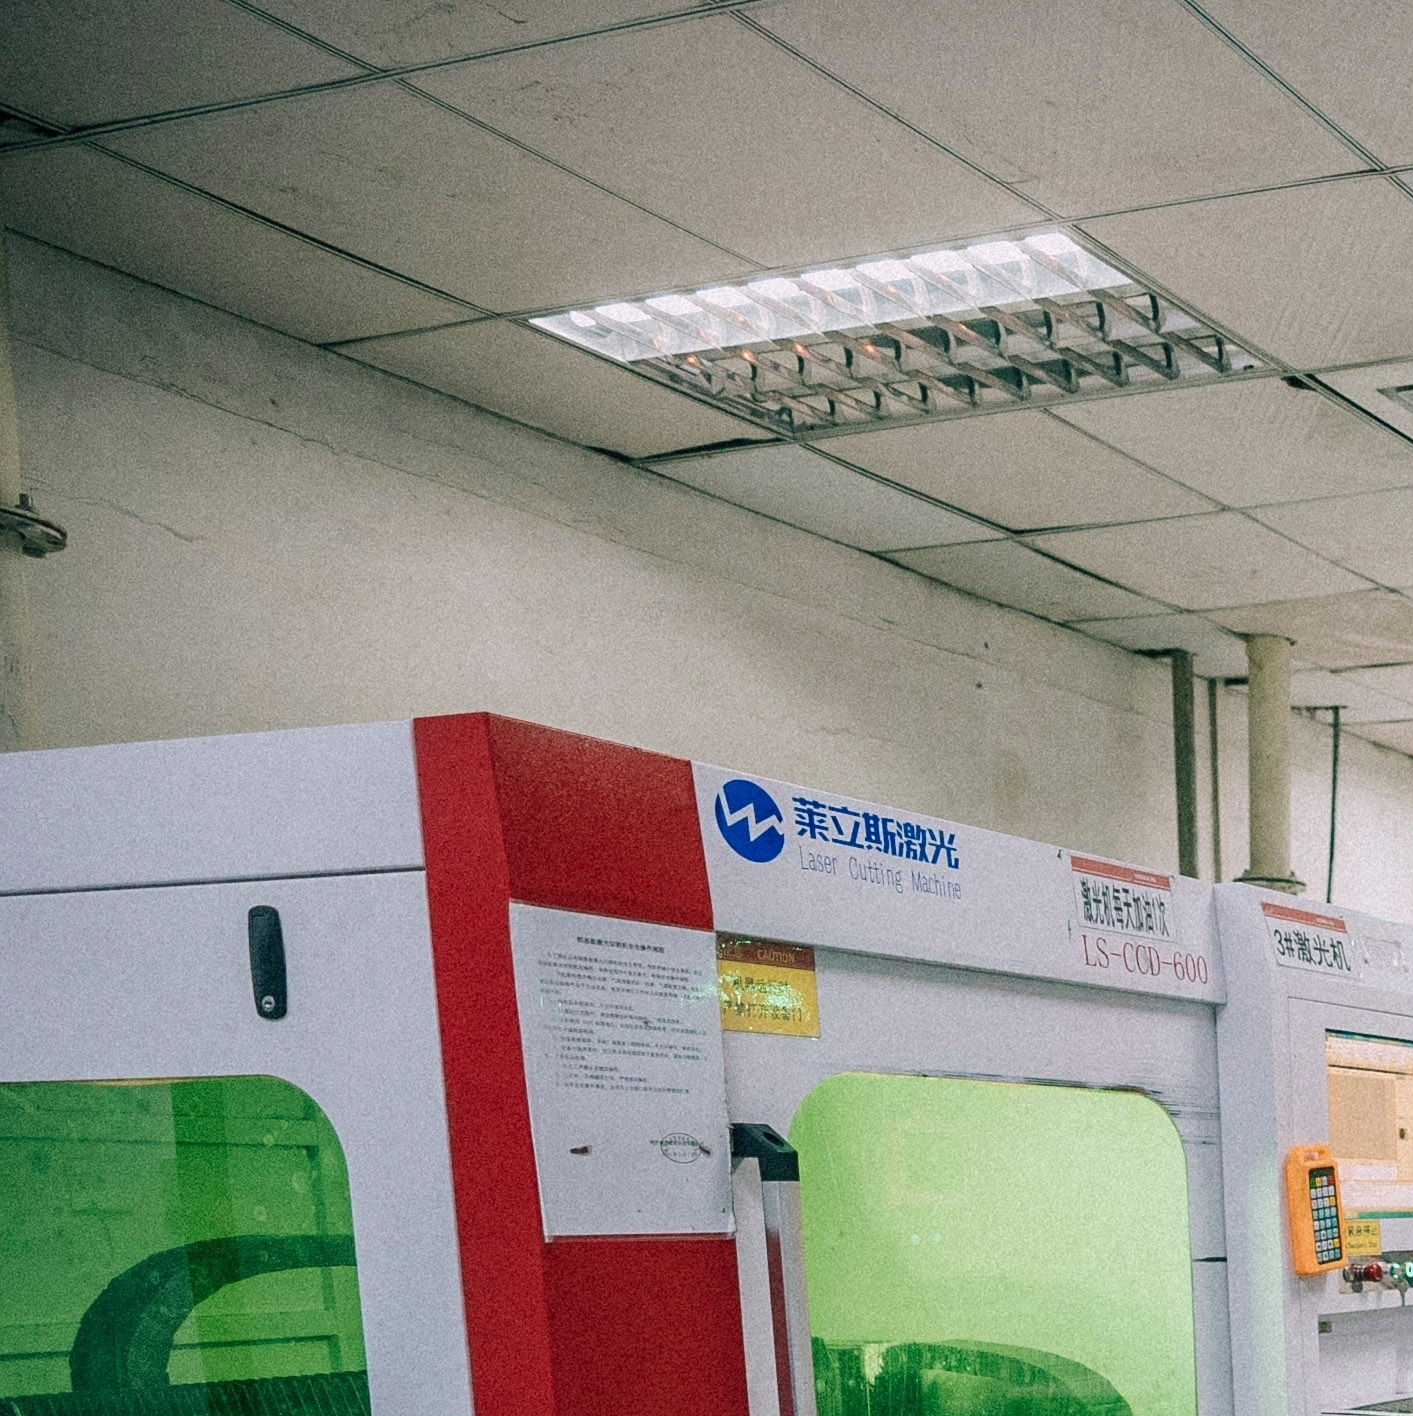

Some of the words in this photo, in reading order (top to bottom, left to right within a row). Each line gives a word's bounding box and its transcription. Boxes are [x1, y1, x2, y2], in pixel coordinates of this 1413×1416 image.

[791, 796, 960, 870] 莱立斯激光
[799, 845, 838, 875] Laser
[849, 857, 903, 894] Cutting
[911, 870, 963, 899] Machine
[757, 948, 796, 964] CAUTION
[1081, 934, 1208, 985] LS-CCD-600
[1273, 929, 1351, 972] 3#激光机
